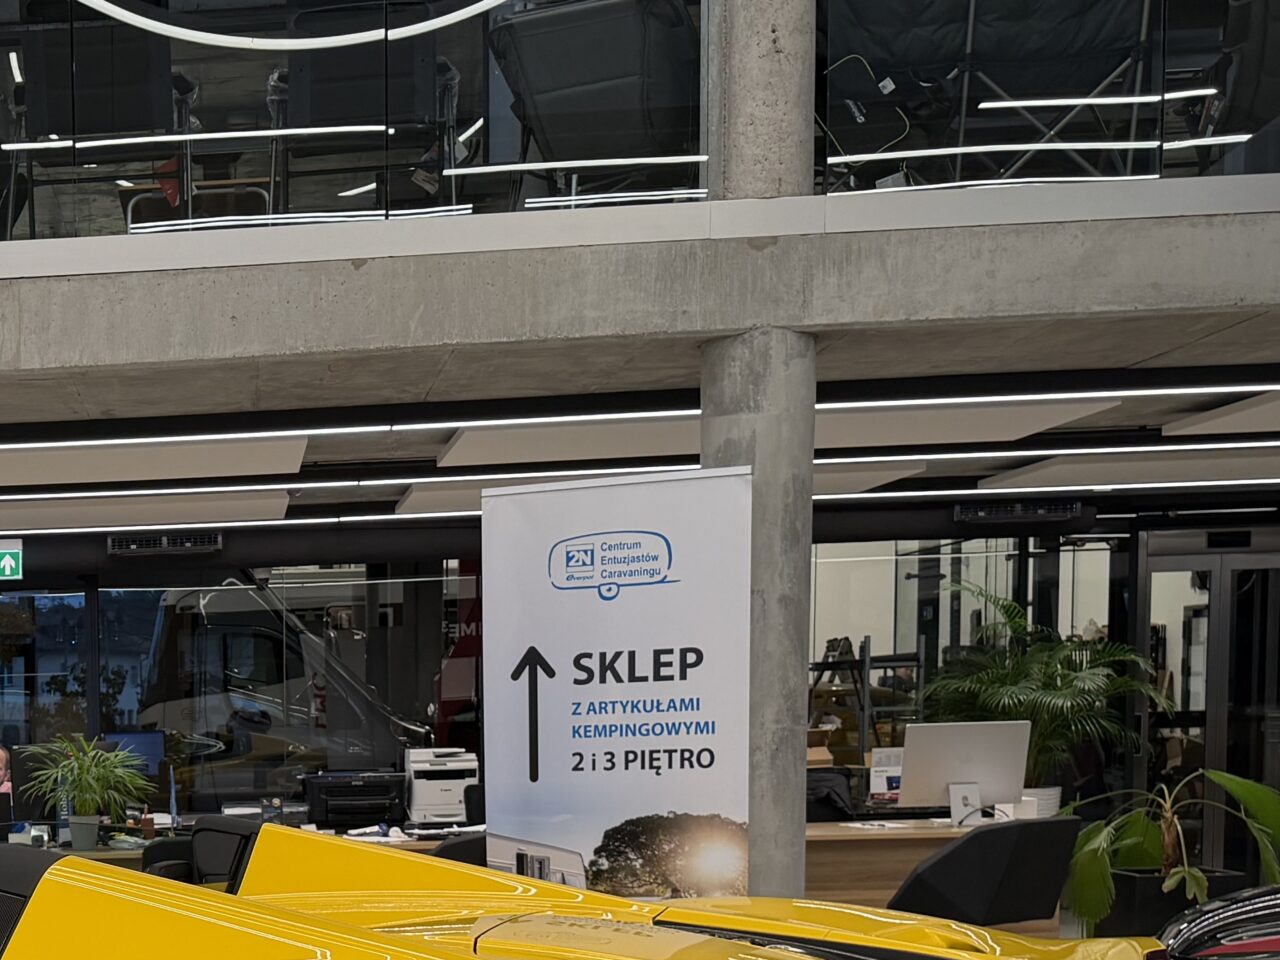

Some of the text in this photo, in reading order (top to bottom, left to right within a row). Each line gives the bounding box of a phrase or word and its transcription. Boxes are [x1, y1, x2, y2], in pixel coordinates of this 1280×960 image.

[600, 541, 641, 552] Centrum
[567, 550, 593, 567] 2N
[600, 553, 659, 566] Entuzjastów
[600, 567, 661, 579] Caravaningu
[572, 647, 704, 686] SKLEP
[571, 697, 700, 715] Z ARTYKUŁAMI
[572, 720, 716, 739] KEMPINGOWYMI
[571, 748, 716, 776] 2 i 3 PIĘTRO
